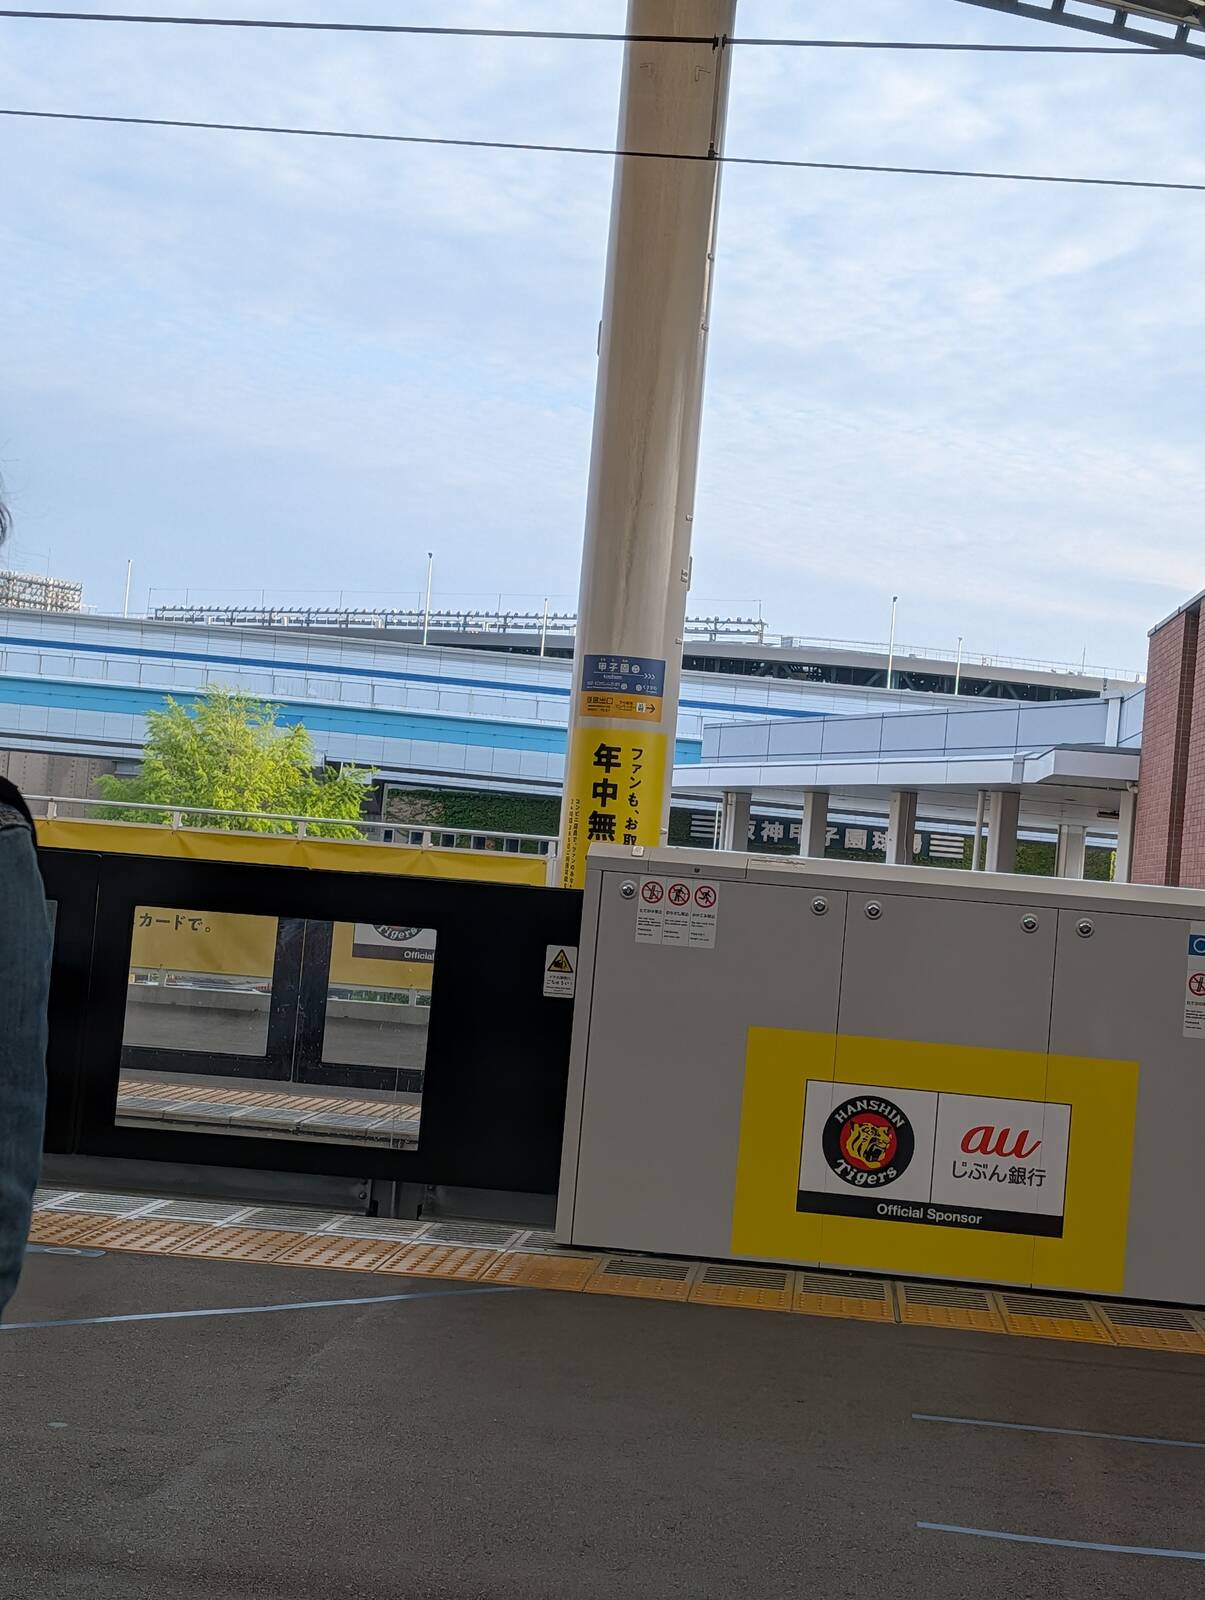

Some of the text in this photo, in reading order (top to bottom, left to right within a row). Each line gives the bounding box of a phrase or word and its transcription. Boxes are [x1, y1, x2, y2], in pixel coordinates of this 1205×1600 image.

[598, 662, 630, 673] 甲子園
[587, 743, 622, 842] 年中無
[139, 912, 212, 933] カードで。
[404, 950, 435, 961] Official
[834, 1099, 905, 1129] HANSHIN
[960, 1125, 1042, 1159] au
[833, 1159, 898, 1185] Tigers
[951, 1160, 1047, 1187] じぶん銀行
[876, 1203, 982, 1225] Official Sponsor
